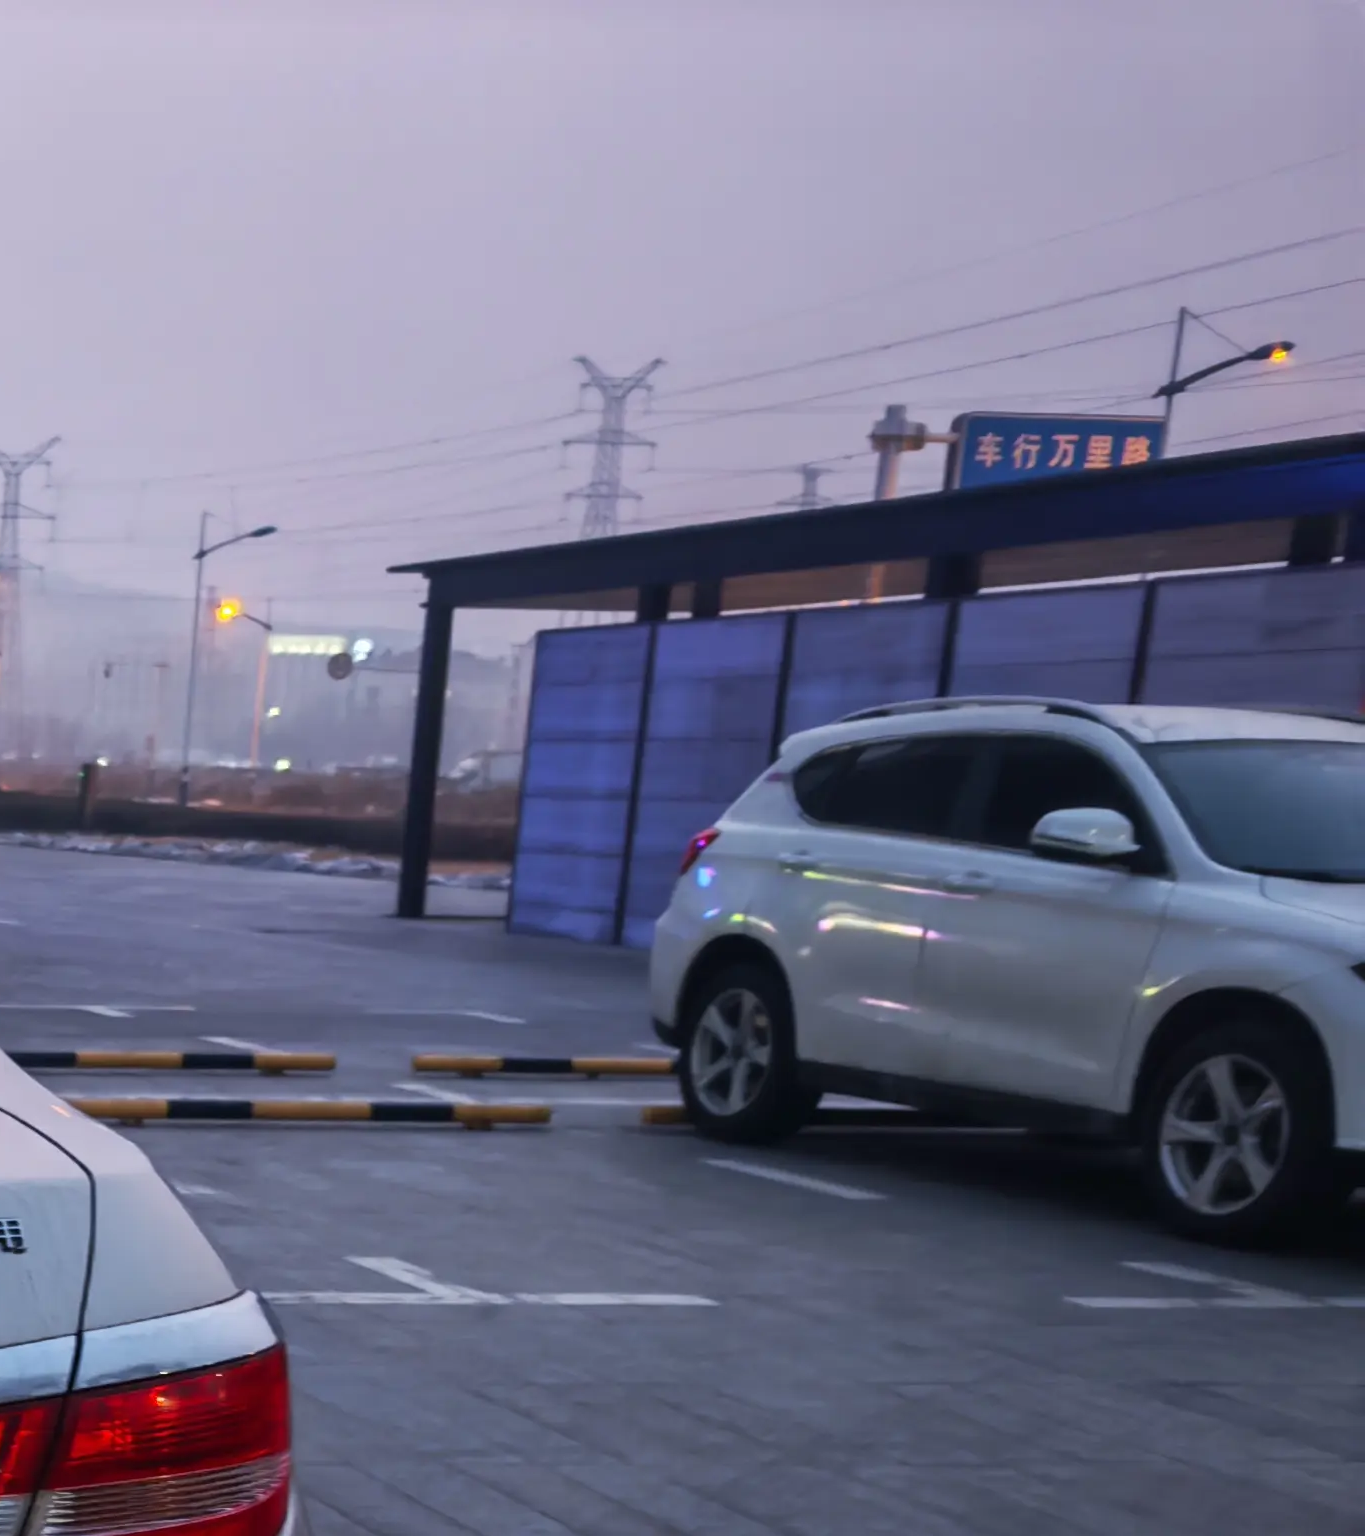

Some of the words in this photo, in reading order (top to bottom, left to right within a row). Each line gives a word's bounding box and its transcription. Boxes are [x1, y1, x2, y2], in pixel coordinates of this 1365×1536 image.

[974, 432, 1151, 469] 车行万里路
